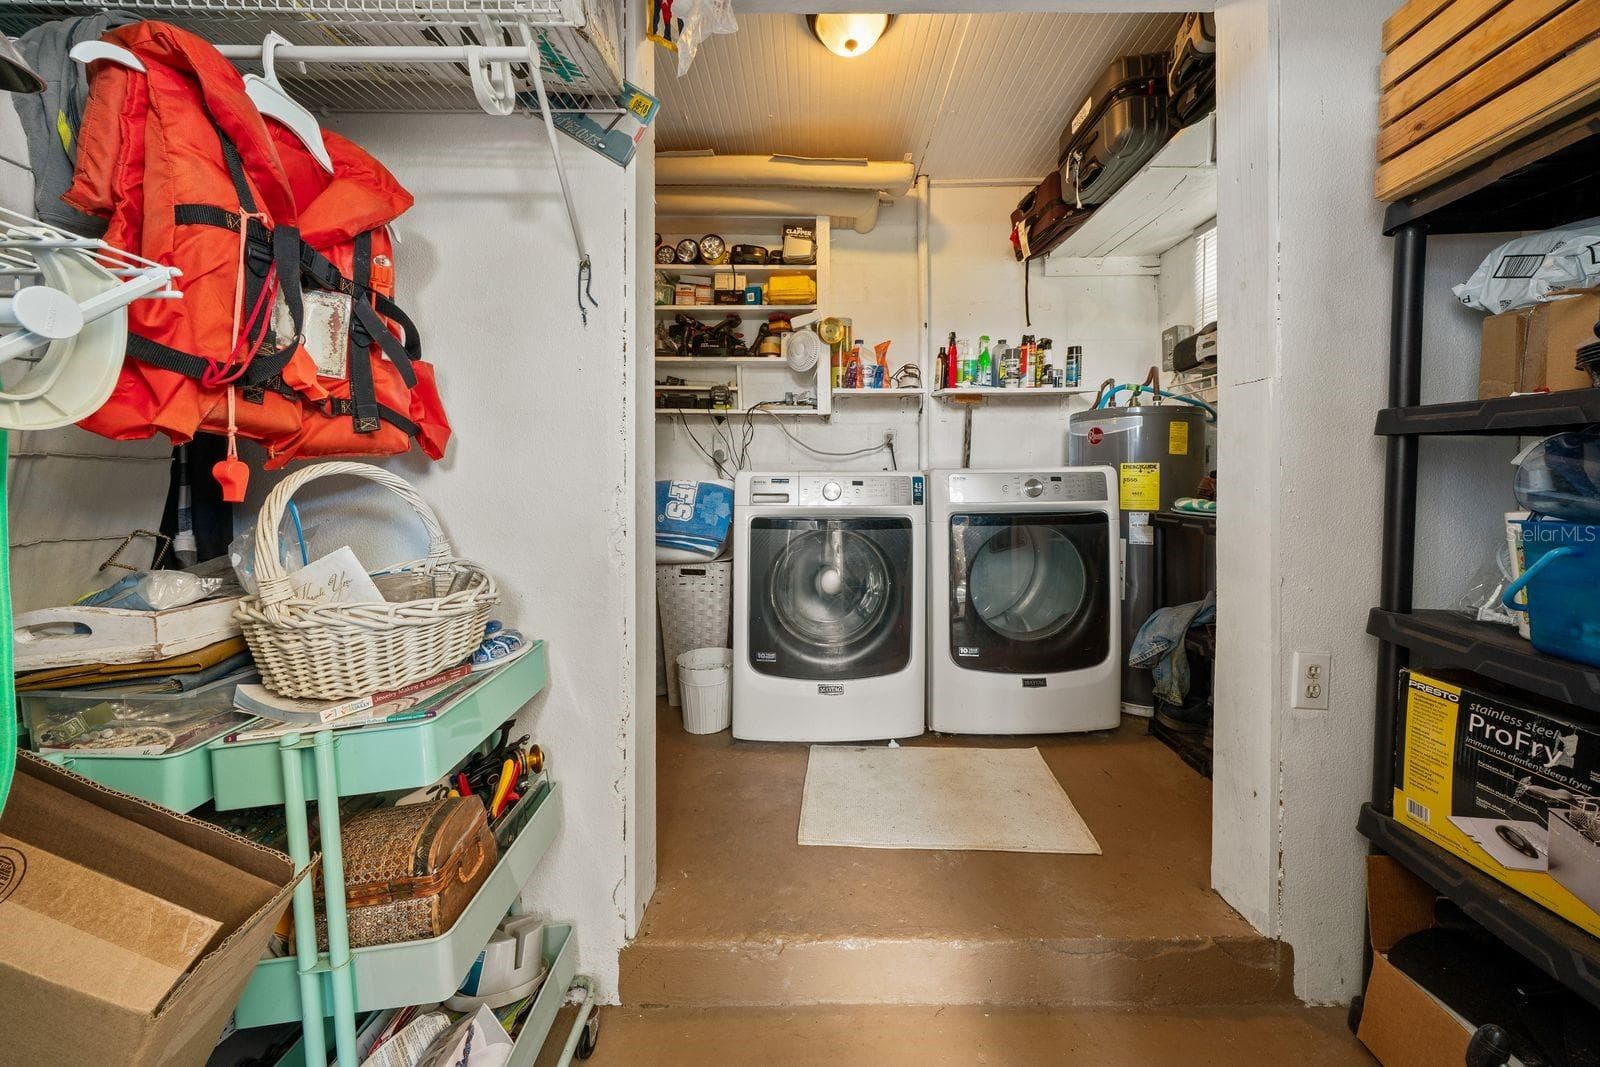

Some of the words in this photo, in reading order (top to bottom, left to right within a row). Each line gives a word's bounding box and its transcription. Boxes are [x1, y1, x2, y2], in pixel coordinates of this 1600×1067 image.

[1408, 680, 1459, 702] PRESTO
[1468, 713, 1563, 769] ProFry
[1470, 702, 1523, 727] stainless
[1524, 721, 1559, 740] steel
[1465, 736, 1507, 758] immersion
[1543, 768, 1568, 785] deep
[1568, 777, 1593, 793] fryer
